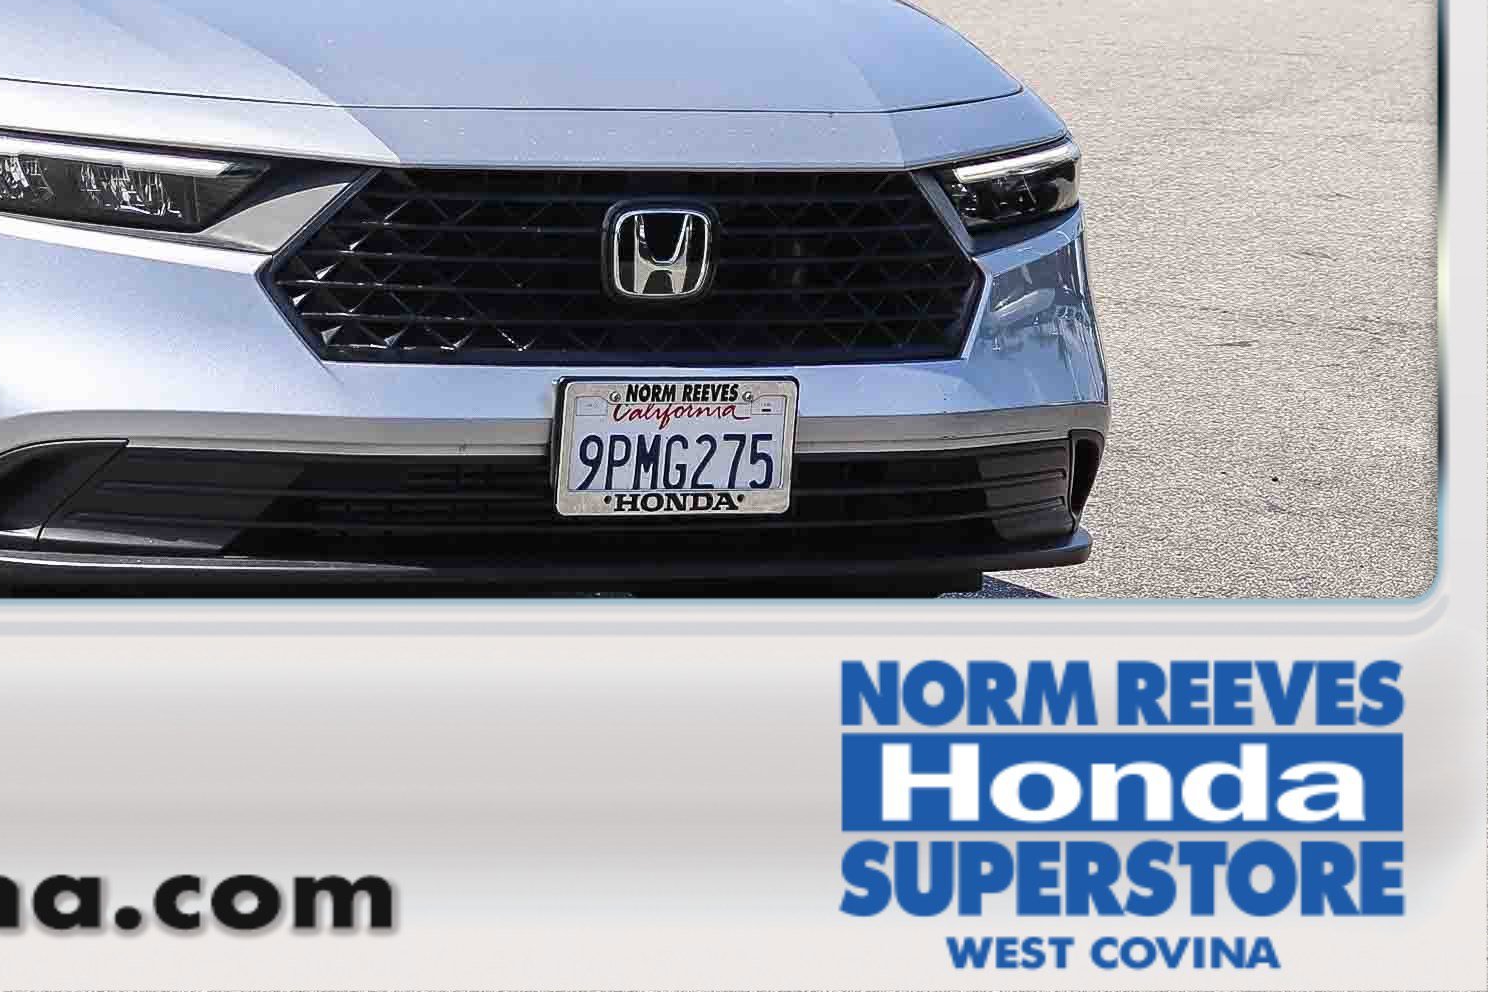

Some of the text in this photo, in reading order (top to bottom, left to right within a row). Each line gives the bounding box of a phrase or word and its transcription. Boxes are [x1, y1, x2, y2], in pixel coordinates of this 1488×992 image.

[626, 384, 739, 402] NORM REEVES
[613, 403, 751, 430] California
[576, 434, 773, 490] 9PMG275
[613, 492, 739, 513] HONDA
